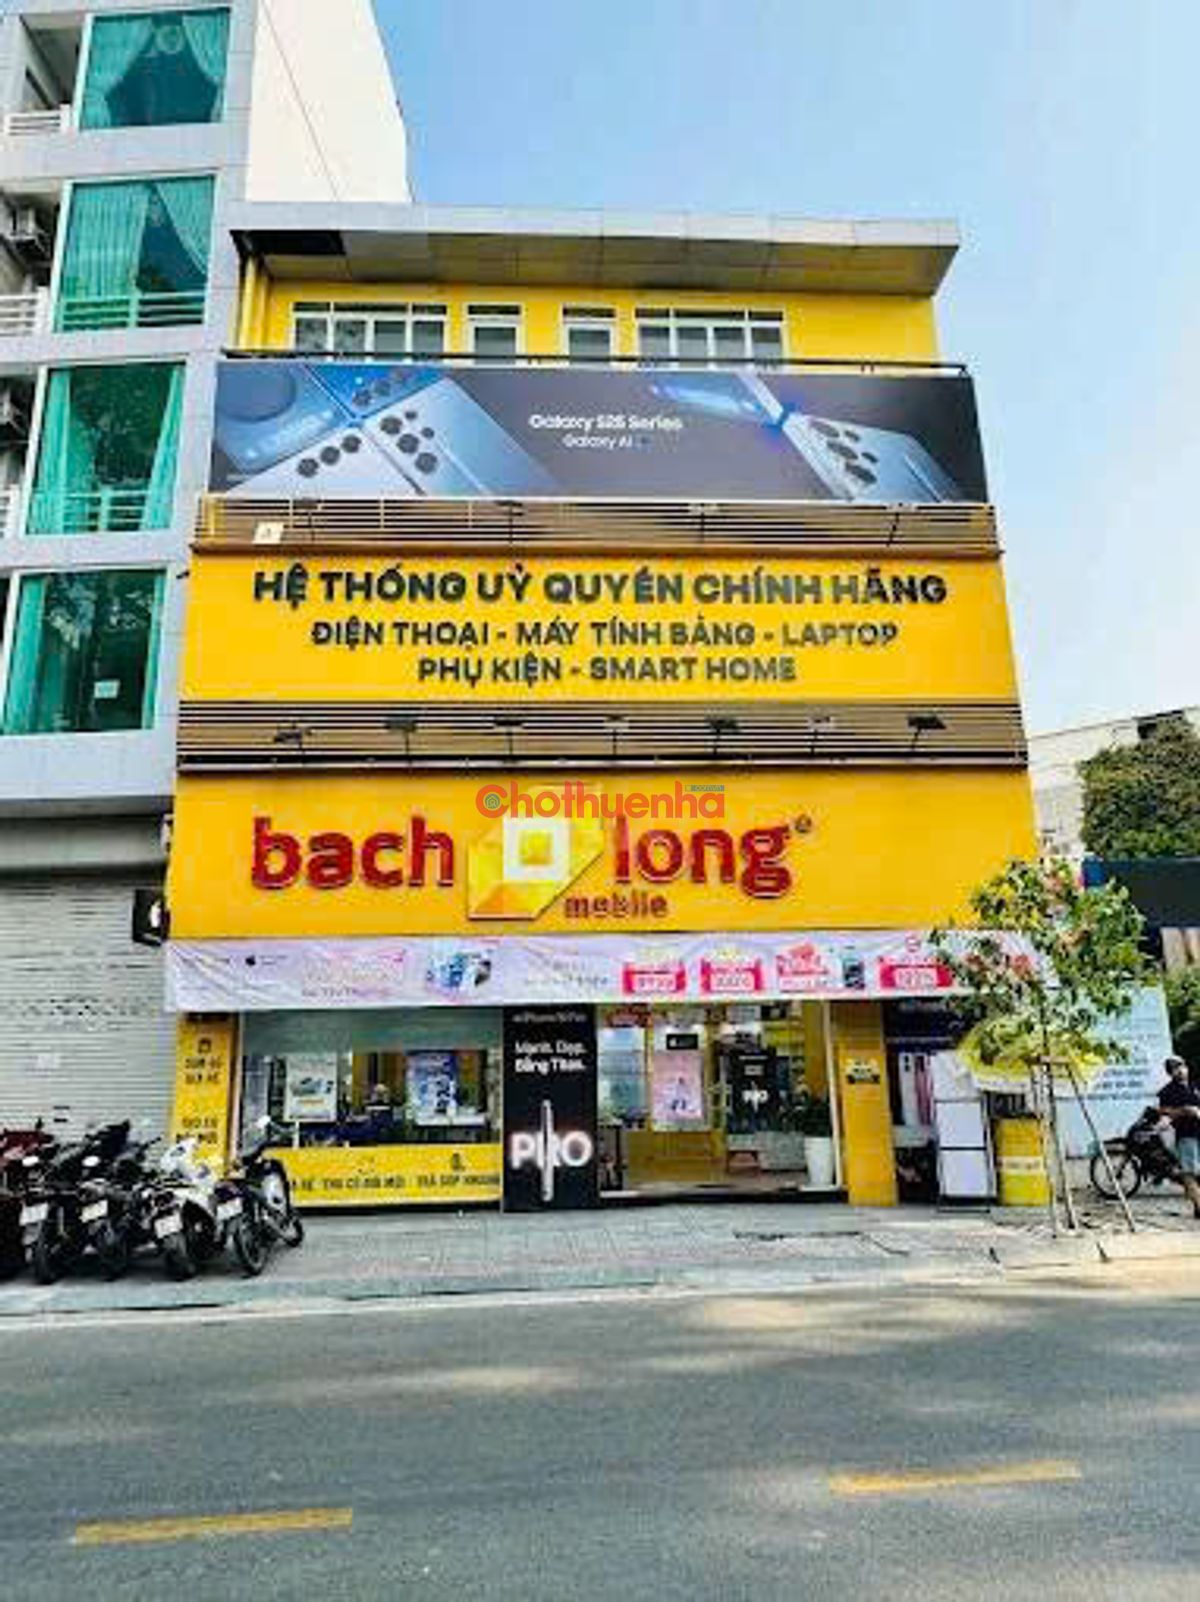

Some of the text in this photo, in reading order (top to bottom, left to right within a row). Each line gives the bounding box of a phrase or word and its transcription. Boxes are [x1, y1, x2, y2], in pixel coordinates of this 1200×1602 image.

[529, 414, 593, 431] Galaxy
[628, 414, 683, 429] Series
[562, 433, 616, 449] Galaxy
[253, 563, 308, 609] HỆ
[693, 566, 822, 604] CHÍNH
[311, 616, 384, 649] ĐIỆN
[392, 621, 489, 650] THOẠI
[516, 616, 579, 645] MÁY
[590, 616, 661, 645] TÍNH
[782, 622, 897, 646] LAPTOP
[418, 657, 482, 687] PHỤ
[491, 651, 562, 686] KIỆN
[590, 657, 697, 681] SMART
[706, 657, 796, 681] HOME
[252, 814, 792, 899] bach long
[564, 891, 668, 919] mobile
